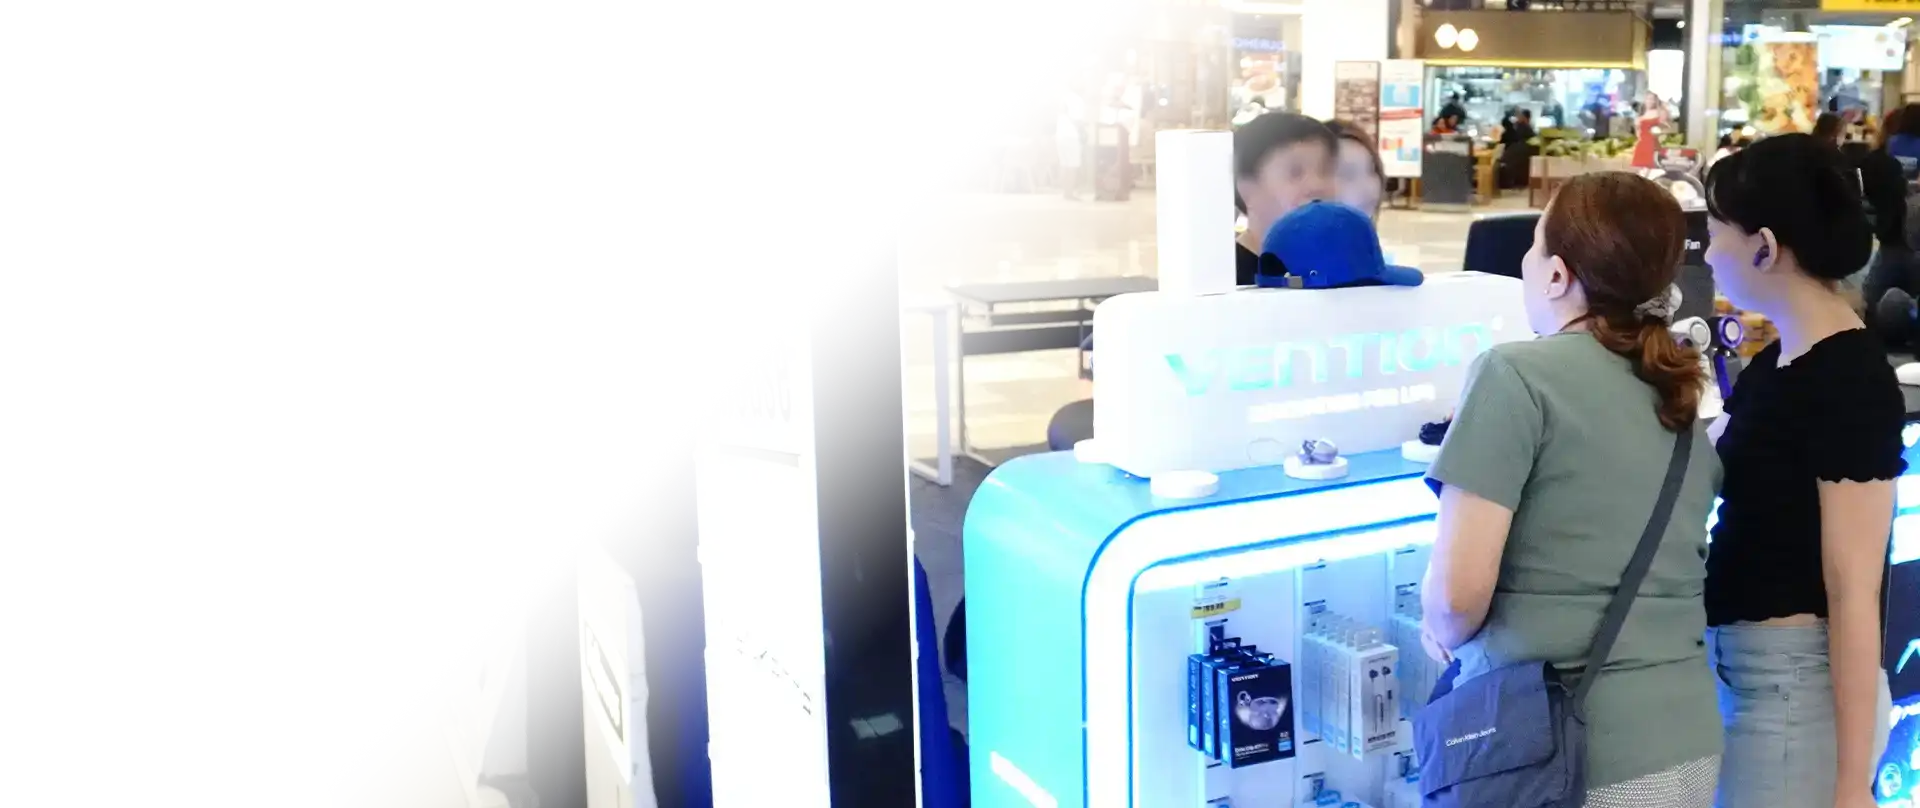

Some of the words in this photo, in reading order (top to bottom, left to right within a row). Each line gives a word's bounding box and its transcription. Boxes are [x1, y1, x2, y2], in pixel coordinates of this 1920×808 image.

[1684, 239, 1701, 250] Fan
[1464, 732, 1479, 741] Klein
[1479, 727, 1497, 738] Jeans
